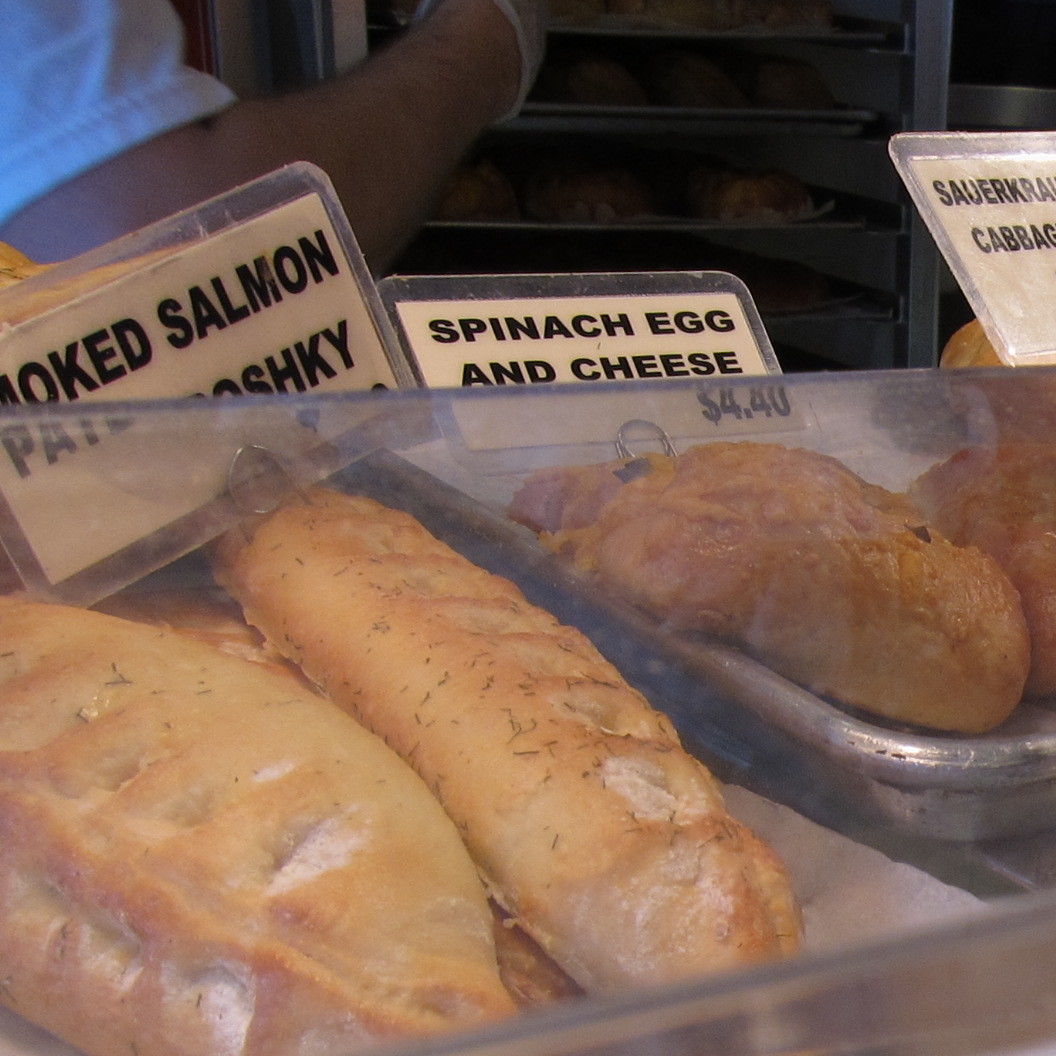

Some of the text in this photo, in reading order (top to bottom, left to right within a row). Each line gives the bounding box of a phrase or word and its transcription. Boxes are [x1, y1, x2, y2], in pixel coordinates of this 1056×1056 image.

[157, 230, 339, 349] SALMON
[428, 310, 736, 343] SPINACH EGG
[461, 351, 743, 386] AND CHEESE
[696, 383, 791, 426] $4.40
